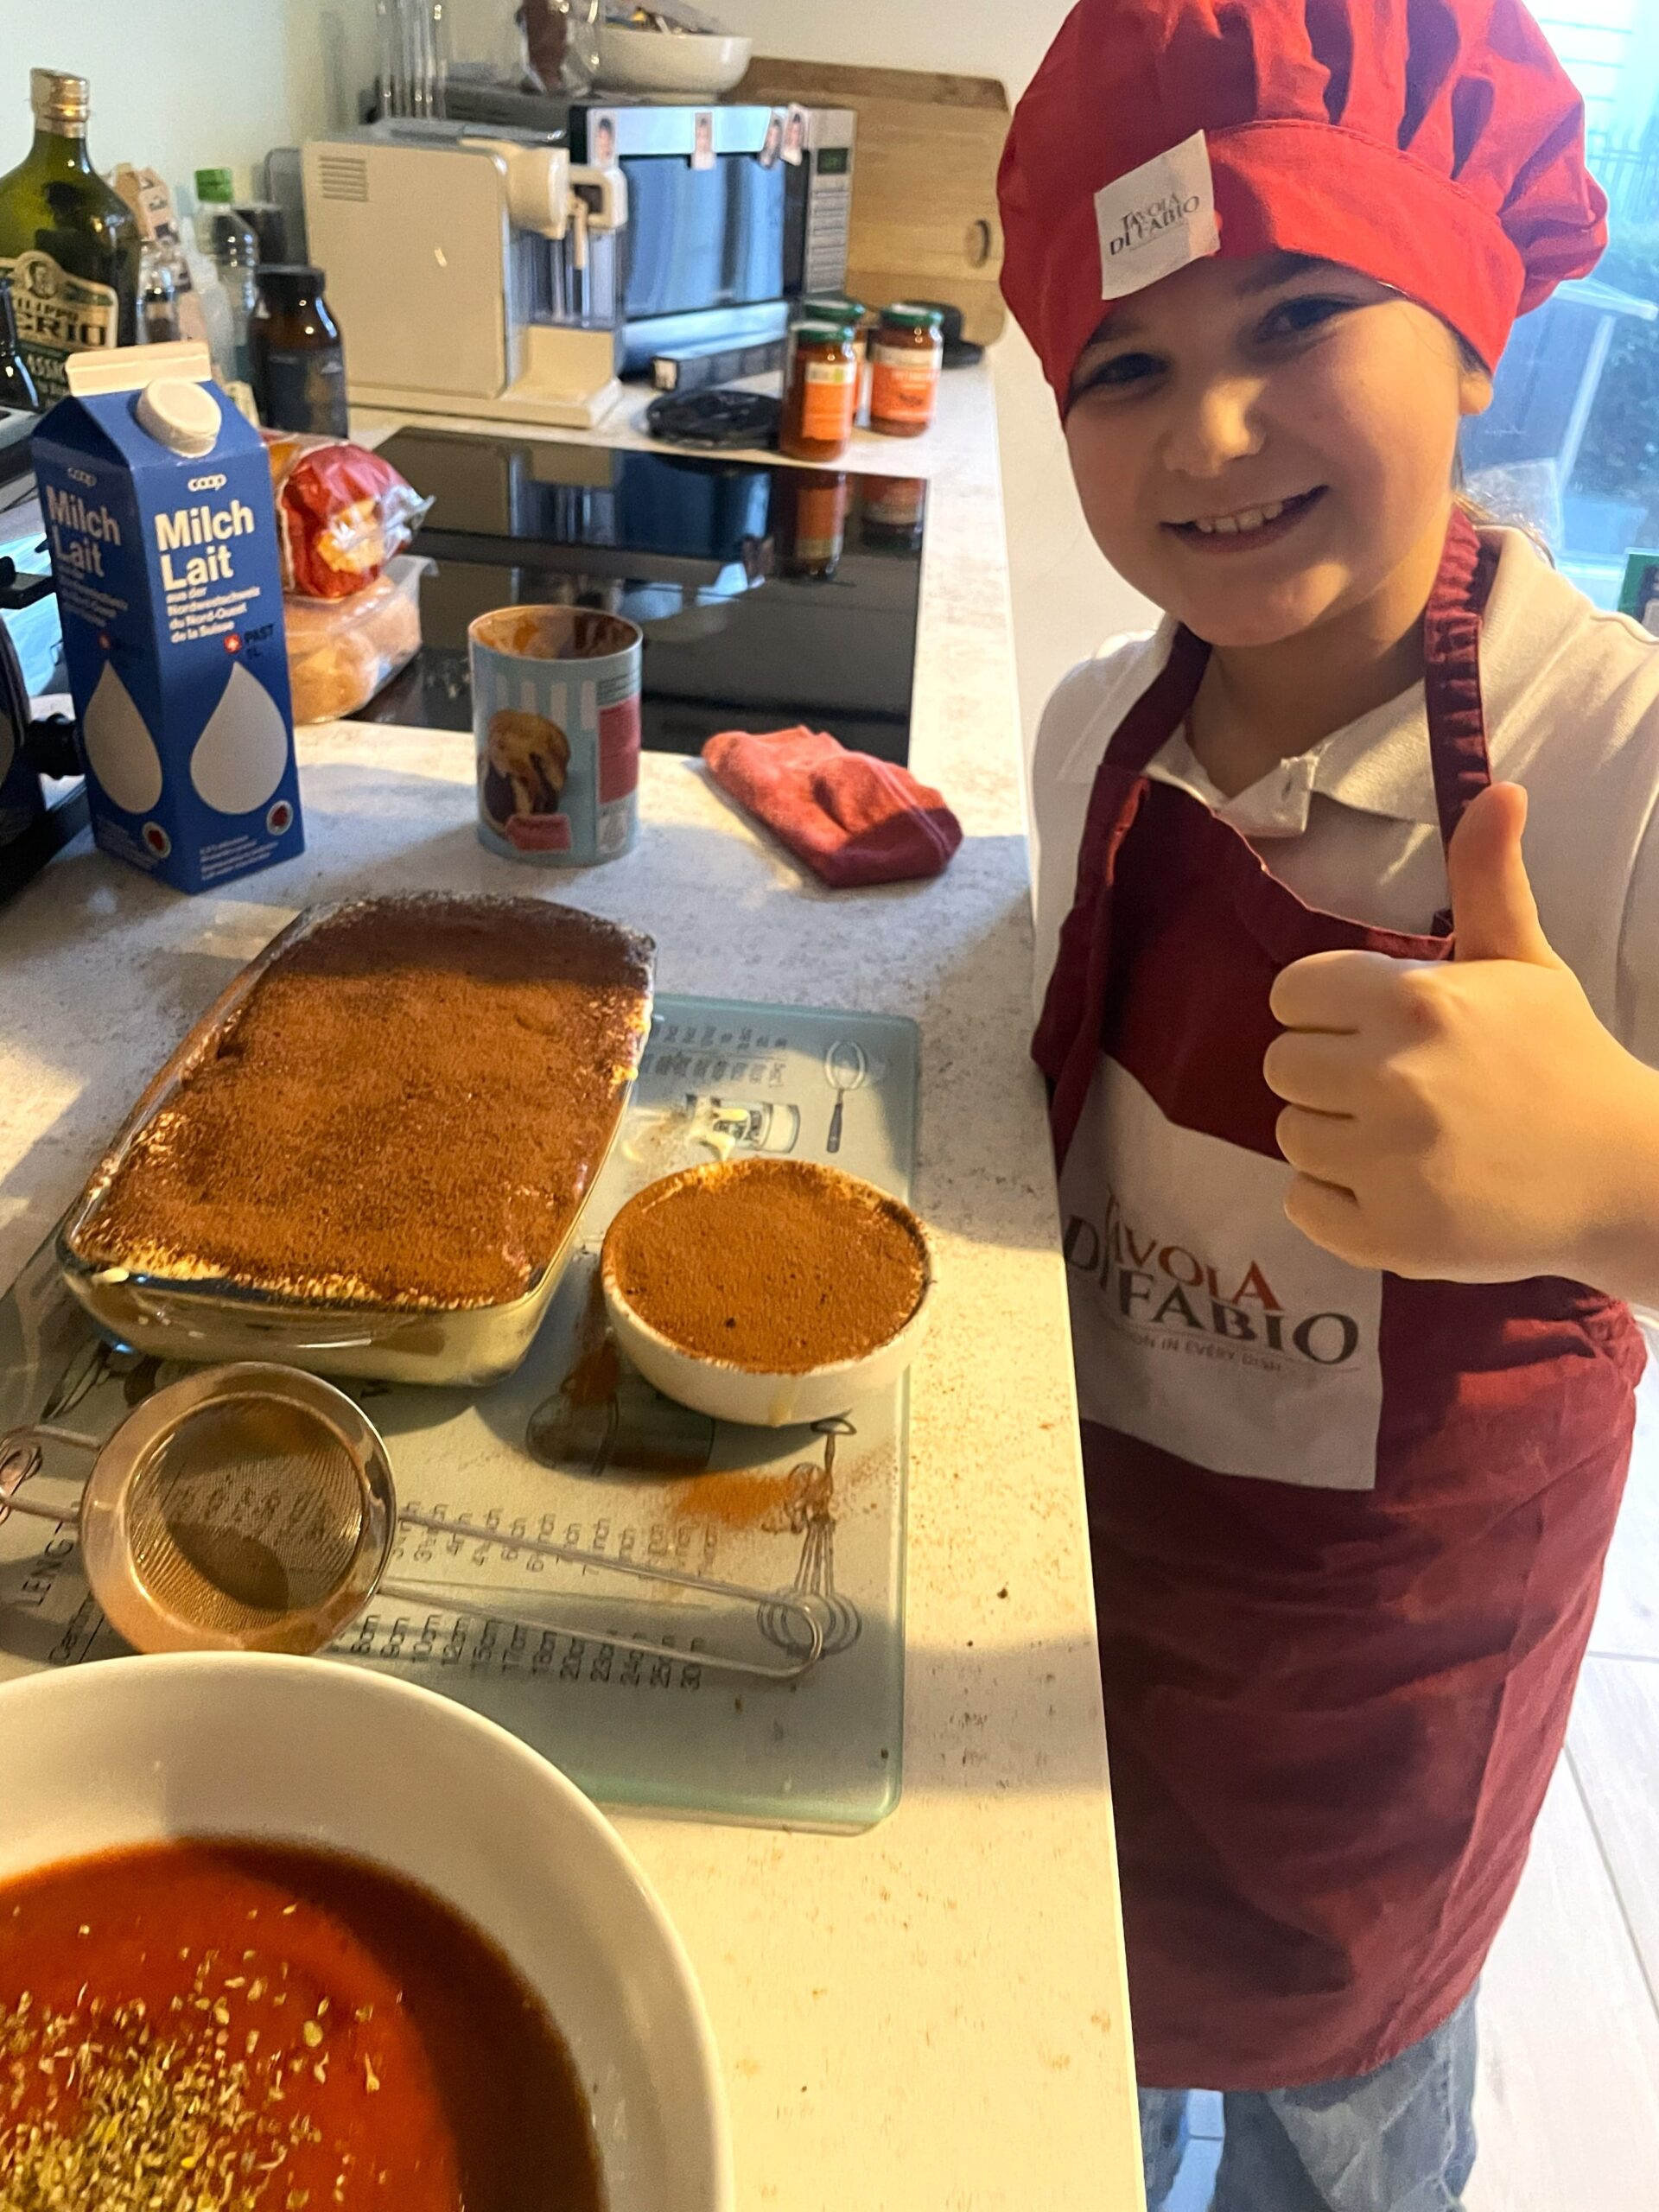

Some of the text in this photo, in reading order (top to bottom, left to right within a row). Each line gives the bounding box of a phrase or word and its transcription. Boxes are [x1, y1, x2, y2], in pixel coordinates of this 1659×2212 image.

[187, 473, 228, 493] coop
[46, 484, 122, 546] Milch
[154, 499, 256, 552] Milch
[53, 524, 105, 578] Lait
[160, 543, 235, 592] Lait
[1118, 1265, 1359, 1365] FABIO
